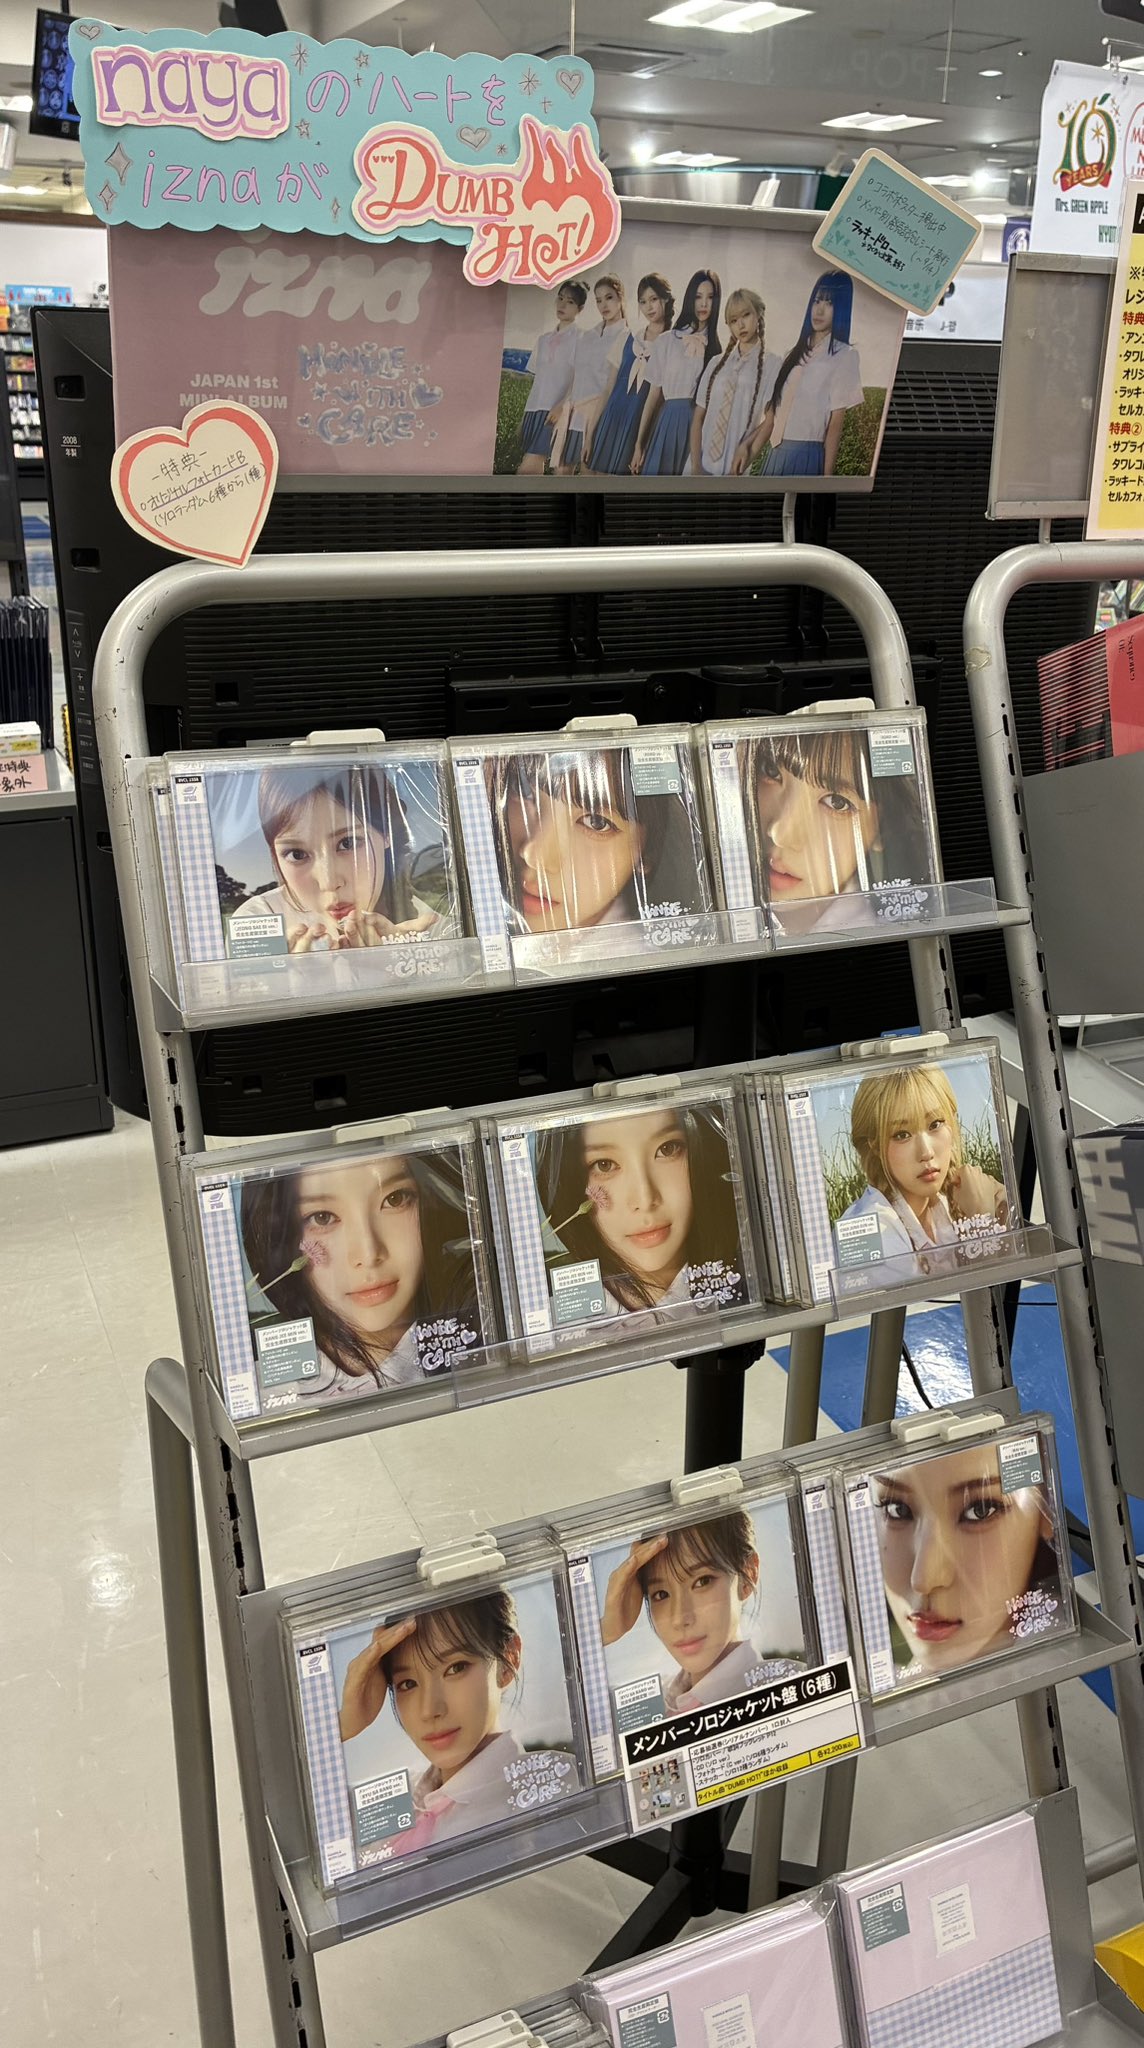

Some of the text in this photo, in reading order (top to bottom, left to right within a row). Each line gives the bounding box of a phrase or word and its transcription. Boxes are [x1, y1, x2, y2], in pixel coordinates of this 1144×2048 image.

[100, 53, 507, 126] naya のハートを
[365, 135, 515, 219] DUMB
[1066, 164, 1099, 187] YEARS
[1055, 198, 1108, 214] Mrs. GREEN APPLE
[851, 219, 897, 255] ラッキードロー
[470, 223, 593, 281] HOT!
[190, 375, 279, 389] JAPAN 1st
[62, 436, 78, 445] 2008
[516, 1780, 561, 1807] CARE
